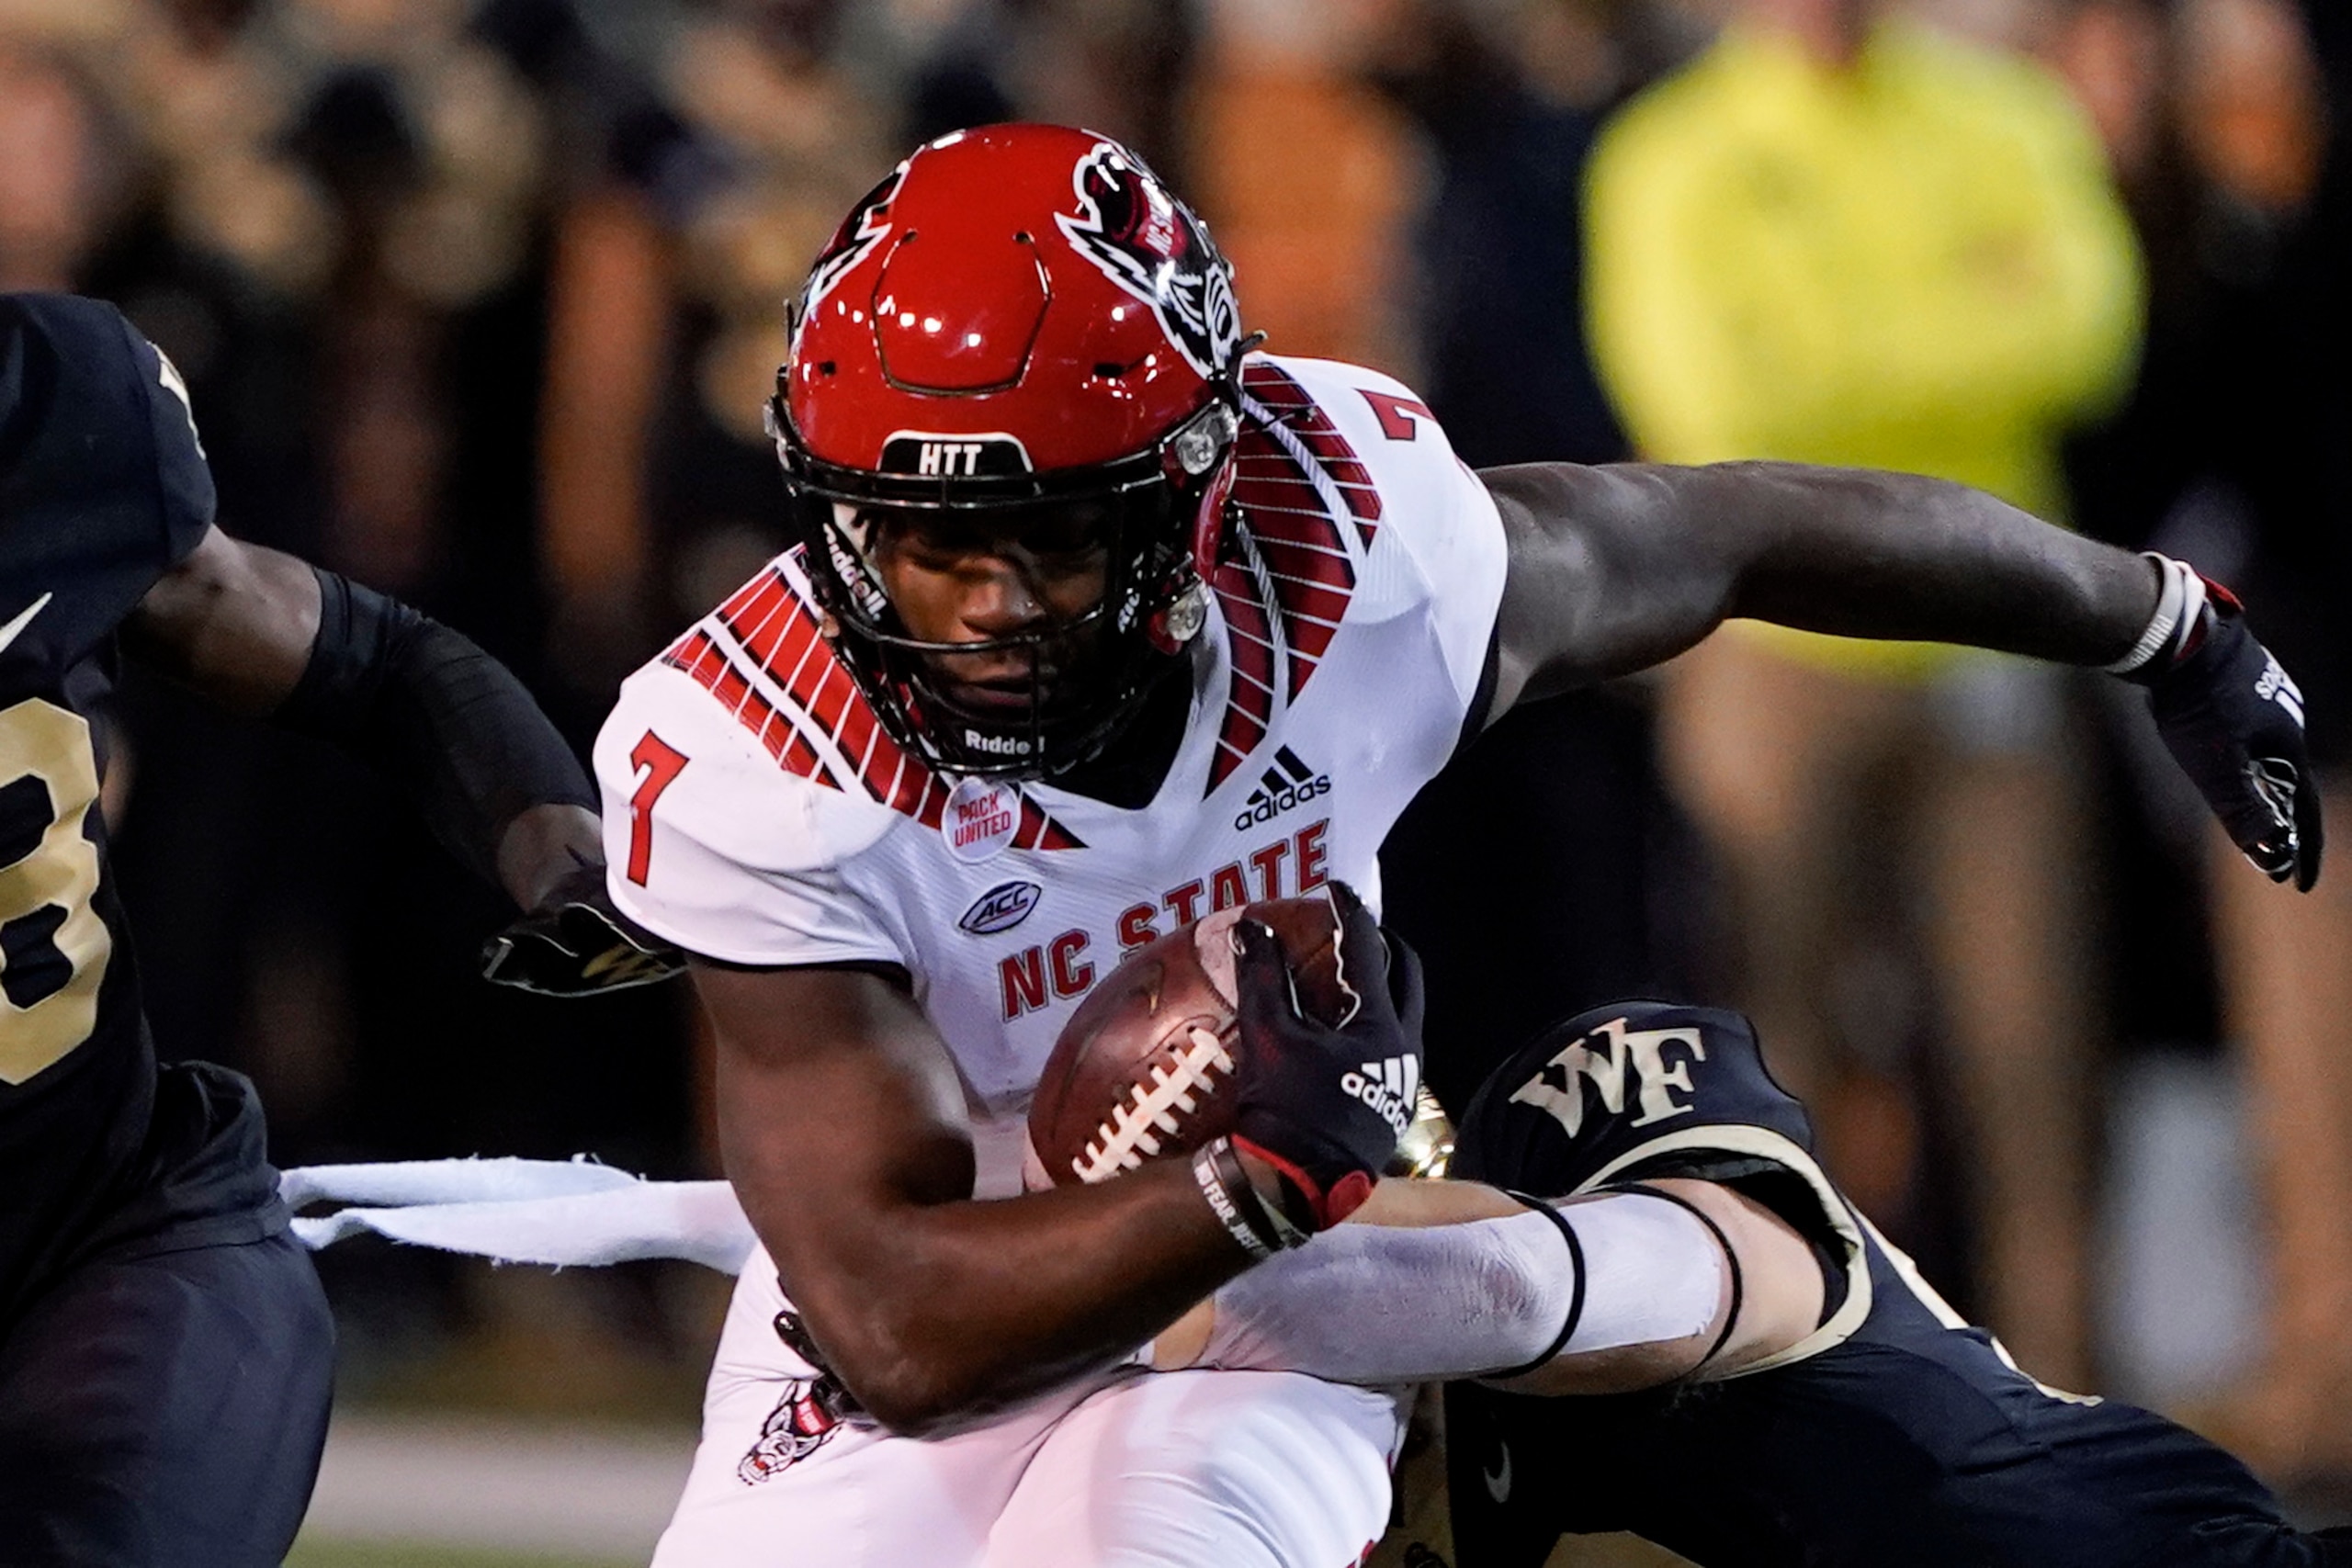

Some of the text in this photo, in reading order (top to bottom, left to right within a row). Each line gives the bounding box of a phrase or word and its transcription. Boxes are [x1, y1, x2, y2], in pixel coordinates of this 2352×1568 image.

[919, 442, 982, 476] HTT
[965, 728, 1046, 755] Riddel
[627, 728, 691, 888] 7
[957, 791, 1000, 824] PACK
[1235, 774, 1331, 831] adidas
[955, 810, 1012, 848] UNITED
[972, 884, 1029, 924] ACC
[997, 818, 1330, 1023] NC STATE
[1509, 1017, 1706, 1139] WF
[1340, 1071, 1408, 1139] adida
